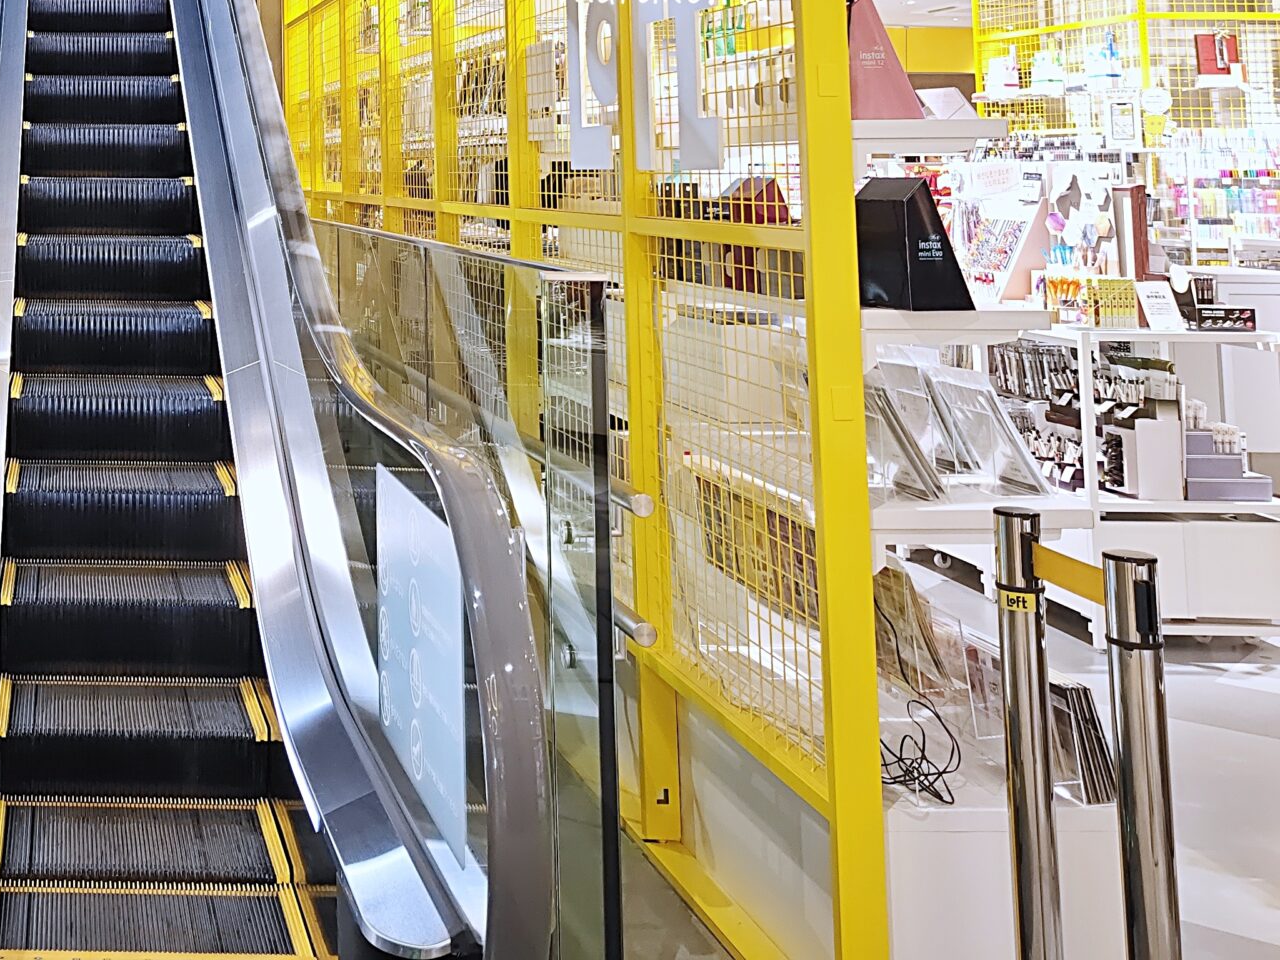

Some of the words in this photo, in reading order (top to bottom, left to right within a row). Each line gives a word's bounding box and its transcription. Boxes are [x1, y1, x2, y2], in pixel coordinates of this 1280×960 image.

[859, 50, 886, 60] instax
[918, 240, 942, 249] instax
[932, 249, 943, 257] Evo
